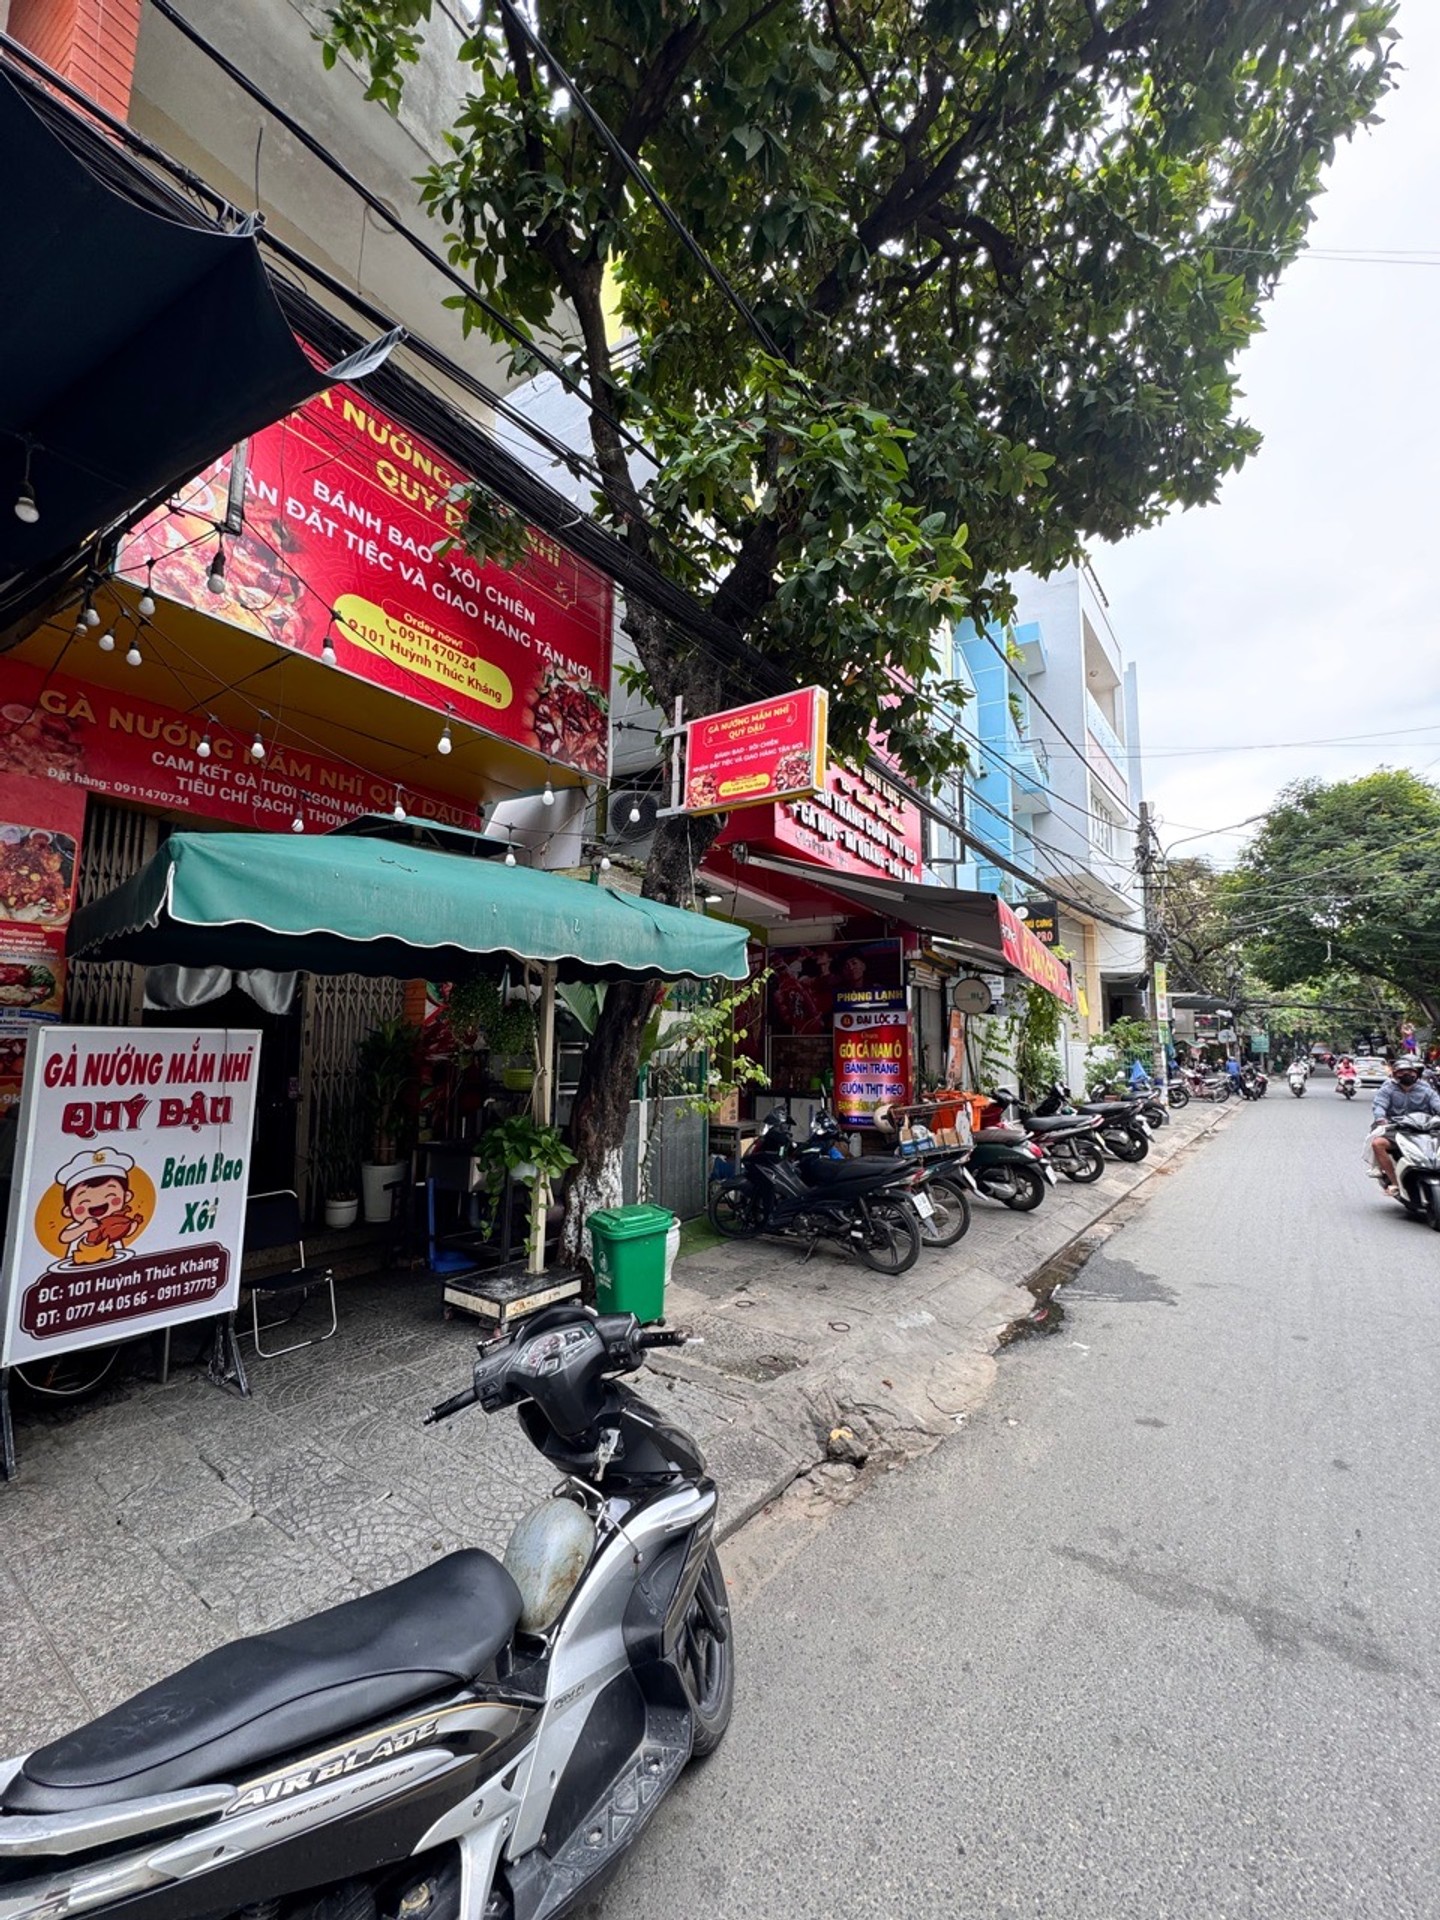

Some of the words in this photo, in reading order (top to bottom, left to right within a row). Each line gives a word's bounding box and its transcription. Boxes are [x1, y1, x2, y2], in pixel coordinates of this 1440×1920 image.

[313, 479, 382, 535] BÁNH
[388, 525, 433, 563] BAO
[450, 562, 480, 593] XÔI
[485, 586, 536, 626] CHIÊN
[285, 496, 339, 538] ĐẶT
[344, 529, 394, 571] TIỆC
[399, 561, 427, 592] VÀ
[432, 582, 479, 618] GIAO
[484, 610, 531, 648] HÀNG
[535, 638, 564, 667] TẬN
[567, 657, 592, 682] NƠI
[399, 625, 477, 673] 0911470734
[403, 612, 436, 635] Order
[438, 629, 463, 649] now!
[361, 624, 385, 647] 101
[390, 639, 432, 668] Huỳnh
[435, 659, 465, 684] Thúc
[467, 674, 502, 704] Kháng
[40, 690, 97, 724] GÀ
[707, 724, 720, 735] GÀ
[47, 767, 71, 783] Đặt
[74, 771, 111, 791] hàng:
[114, 781, 190, 806] 0911470734
[152, 751, 194, 774] CAM
[200, 763, 231, 782] KẾT
[234, 772, 257, 789] GÀ
[262, 777, 298, 799] TƯƠI
[176, 775, 216, 797] TIÊU
[220, 786, 249, 805] CHÍ
[252, 794, 294, 815] SẠCH
[837, 990, 873, 1003] PHÒNG
[875, 989, 904, 1002] LẠNH
[856, 1014, 873, 1026] ĐẠI
[893, 1014, 900, 1024] 2
[44, 1043, 77, 1088] GÀ
[82, 1042, 164, 1087] NƯỚNG
[165, 1036, 216, 1084] MẮM
[844, 1060, 868, 1074] BÁNH
[870, 1044, 893, 1059] NAM
[61, 1092, 151, 1140] QUÝ
[160, 1154, 208, 1189] Bánh
[210, 1152, 244, 1183] Bao
[178, 1197, 219, 1234] Xôi
[38, 1286, 64, 1304] ĐC:
[68, 1280, 92, 1298] 101
[95, 1269, 141, 1293] Huỳnh
[144, 1264, 177, 1282] Thúc
[179, 1257, 220, 1275] Kháng
[36, 1310, 61, 1328] ĐT:
[65, 1302, 96, 1322] 0777
[97, 1298, 114, 1314] 44
[116, 1294, 131, 1310] 05
[133, 1290, 148, 1305] 66
[157, 1284, 182, 1301] 0911
[182, 1275, 218, 1298] 377713
[225, 1771, 314, 1816] AIR
[315, 1718, 440, 1786] BLADE
